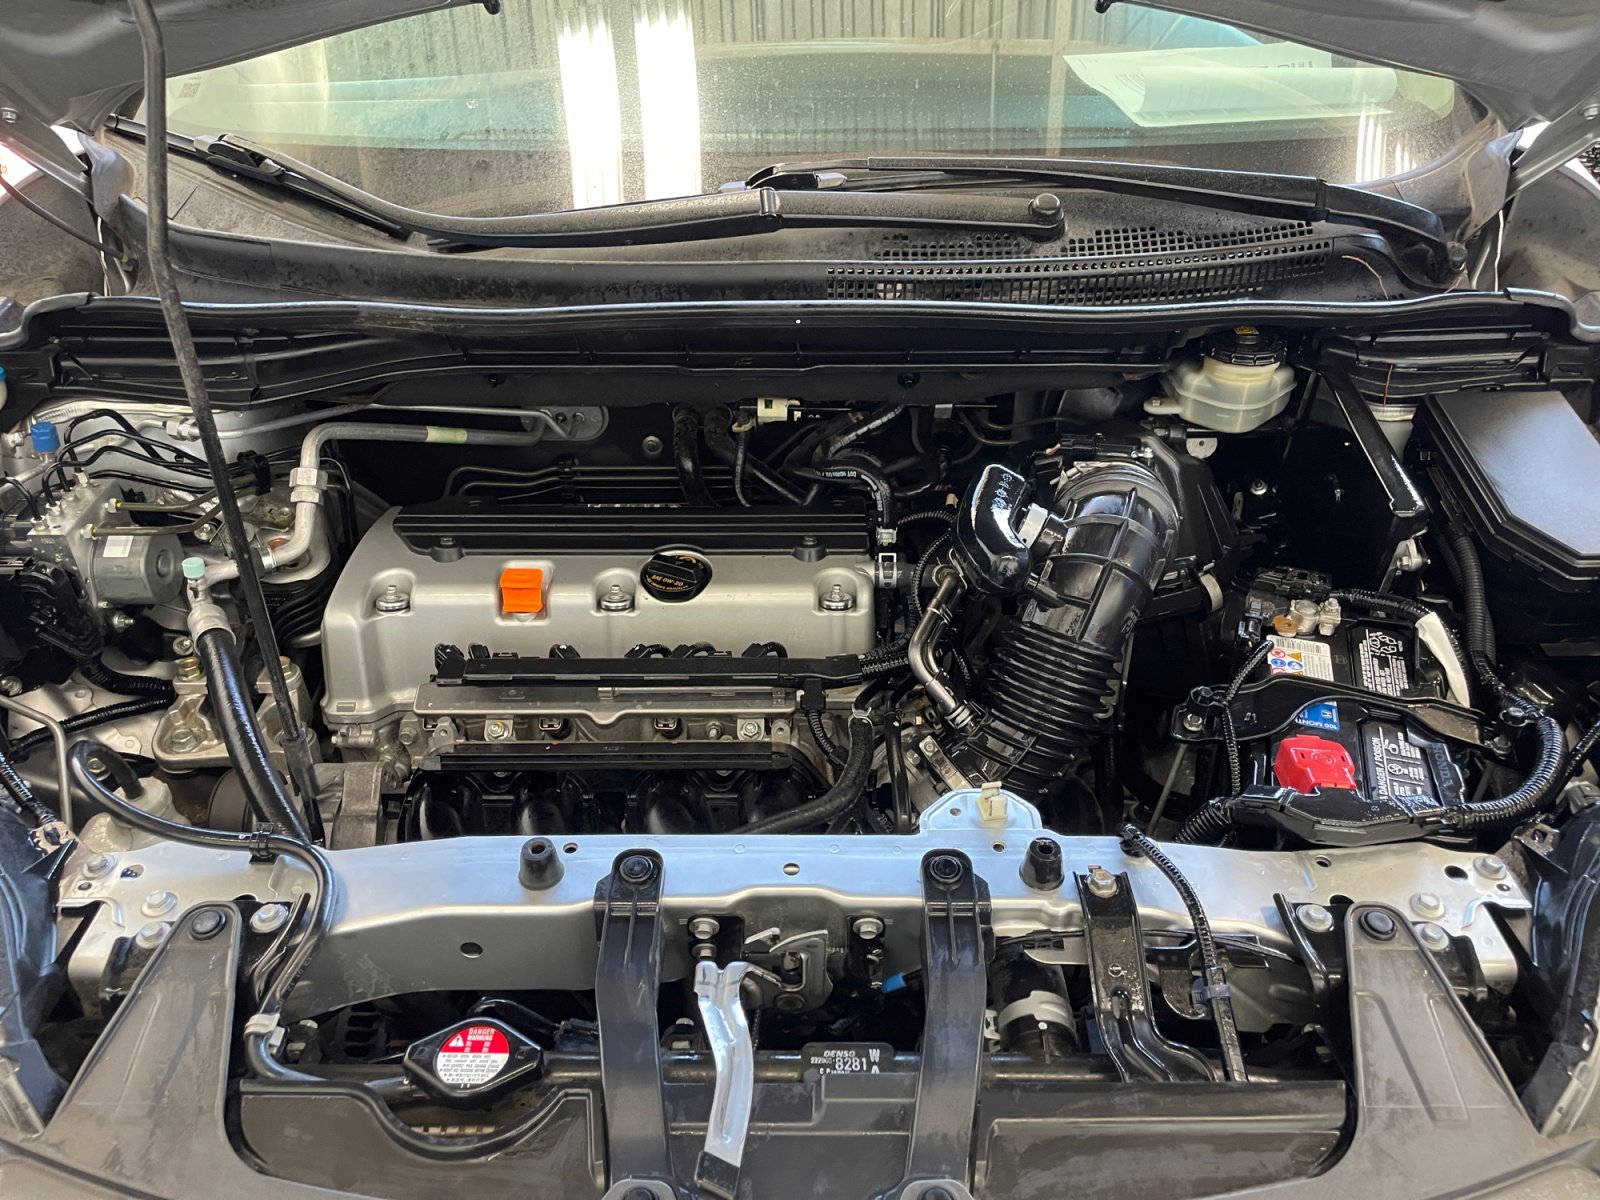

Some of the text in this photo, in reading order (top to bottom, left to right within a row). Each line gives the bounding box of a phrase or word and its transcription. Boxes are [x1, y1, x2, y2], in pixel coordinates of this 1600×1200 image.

[1371, 736, 1383, 762] POISON
[1376, 767, 1388, 795] DANGER
[824, 1050, 856, 1058] DENSO
